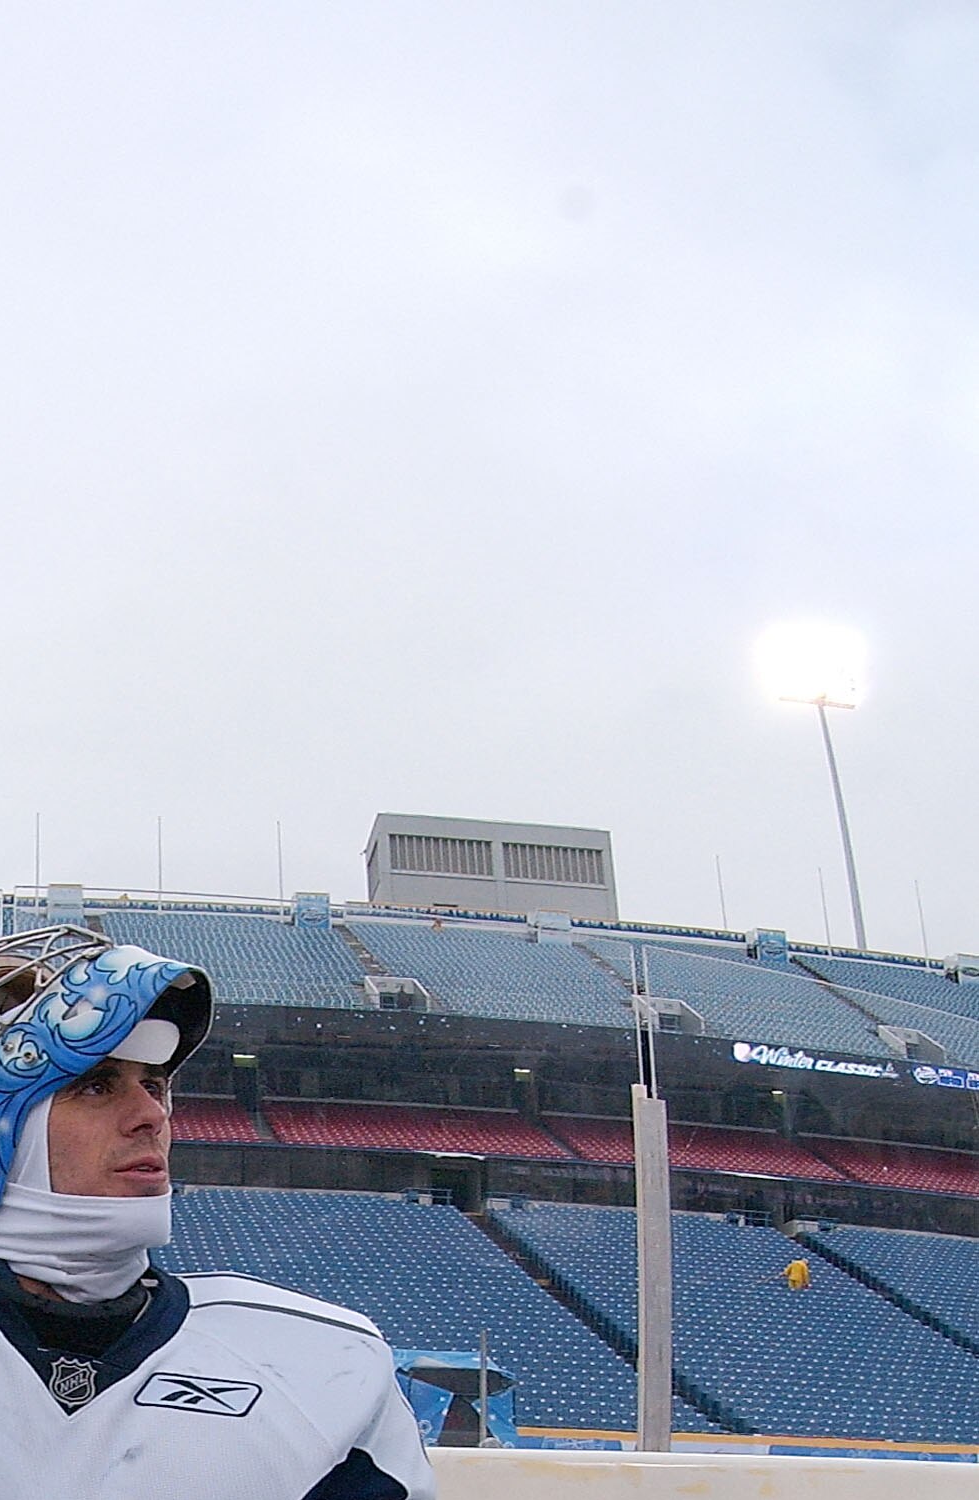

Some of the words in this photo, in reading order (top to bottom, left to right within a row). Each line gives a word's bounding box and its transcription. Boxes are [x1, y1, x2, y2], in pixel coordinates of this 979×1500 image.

[752, 1045, 814, 1069] Winter
[815, 1059, 883, 1078] CLASSIC
[59, 1371, 87, 1393] NHL
